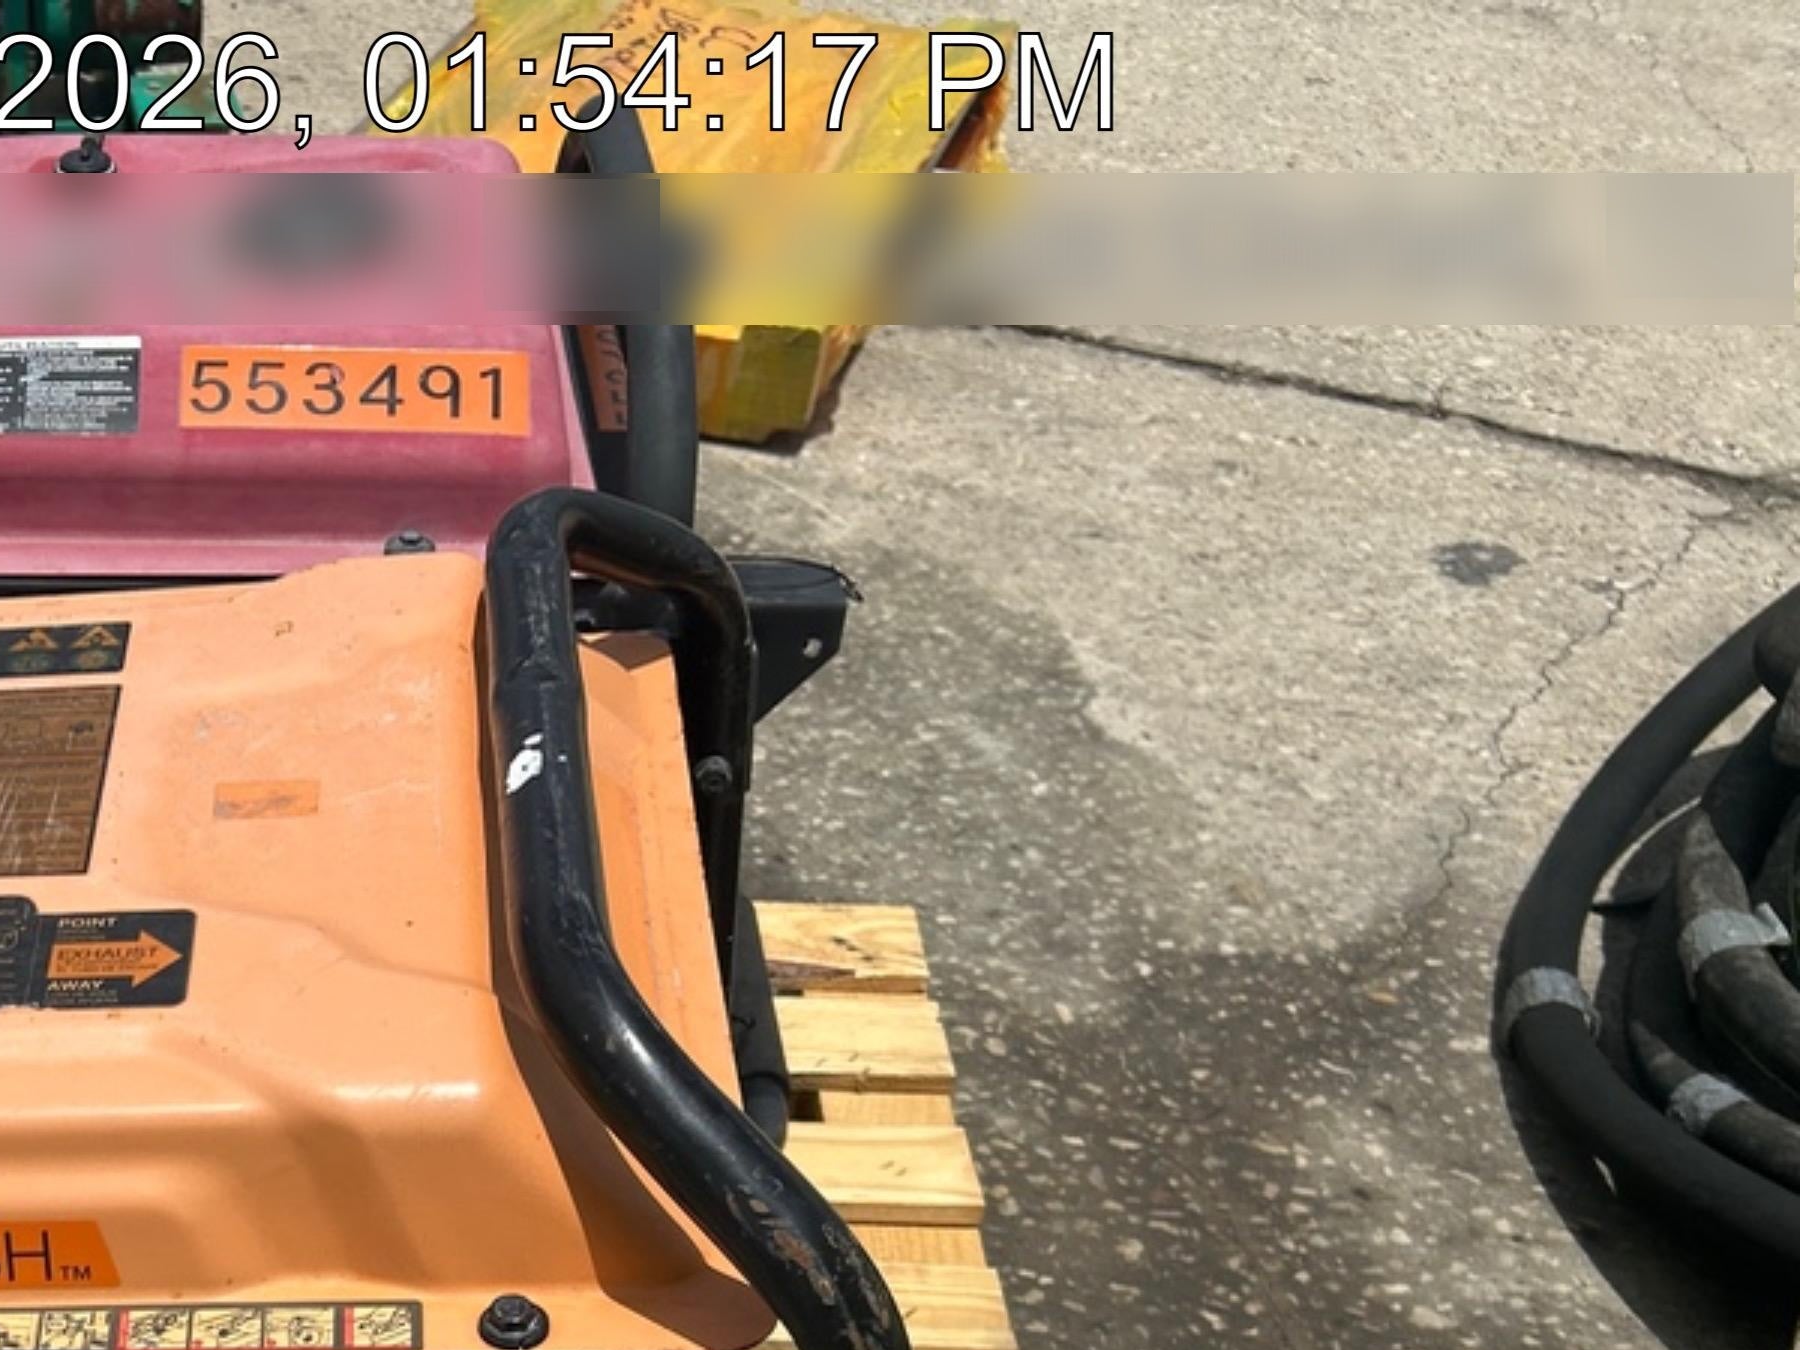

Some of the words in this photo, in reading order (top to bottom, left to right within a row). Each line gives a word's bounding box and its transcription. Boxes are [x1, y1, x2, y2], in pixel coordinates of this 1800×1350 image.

[188, 359, 502, 420] 553491
[57, 917, 118, 929] POINT
[56, 946, 158, 961] EXHAUST
[47, 980, 104, 992] AWAY
